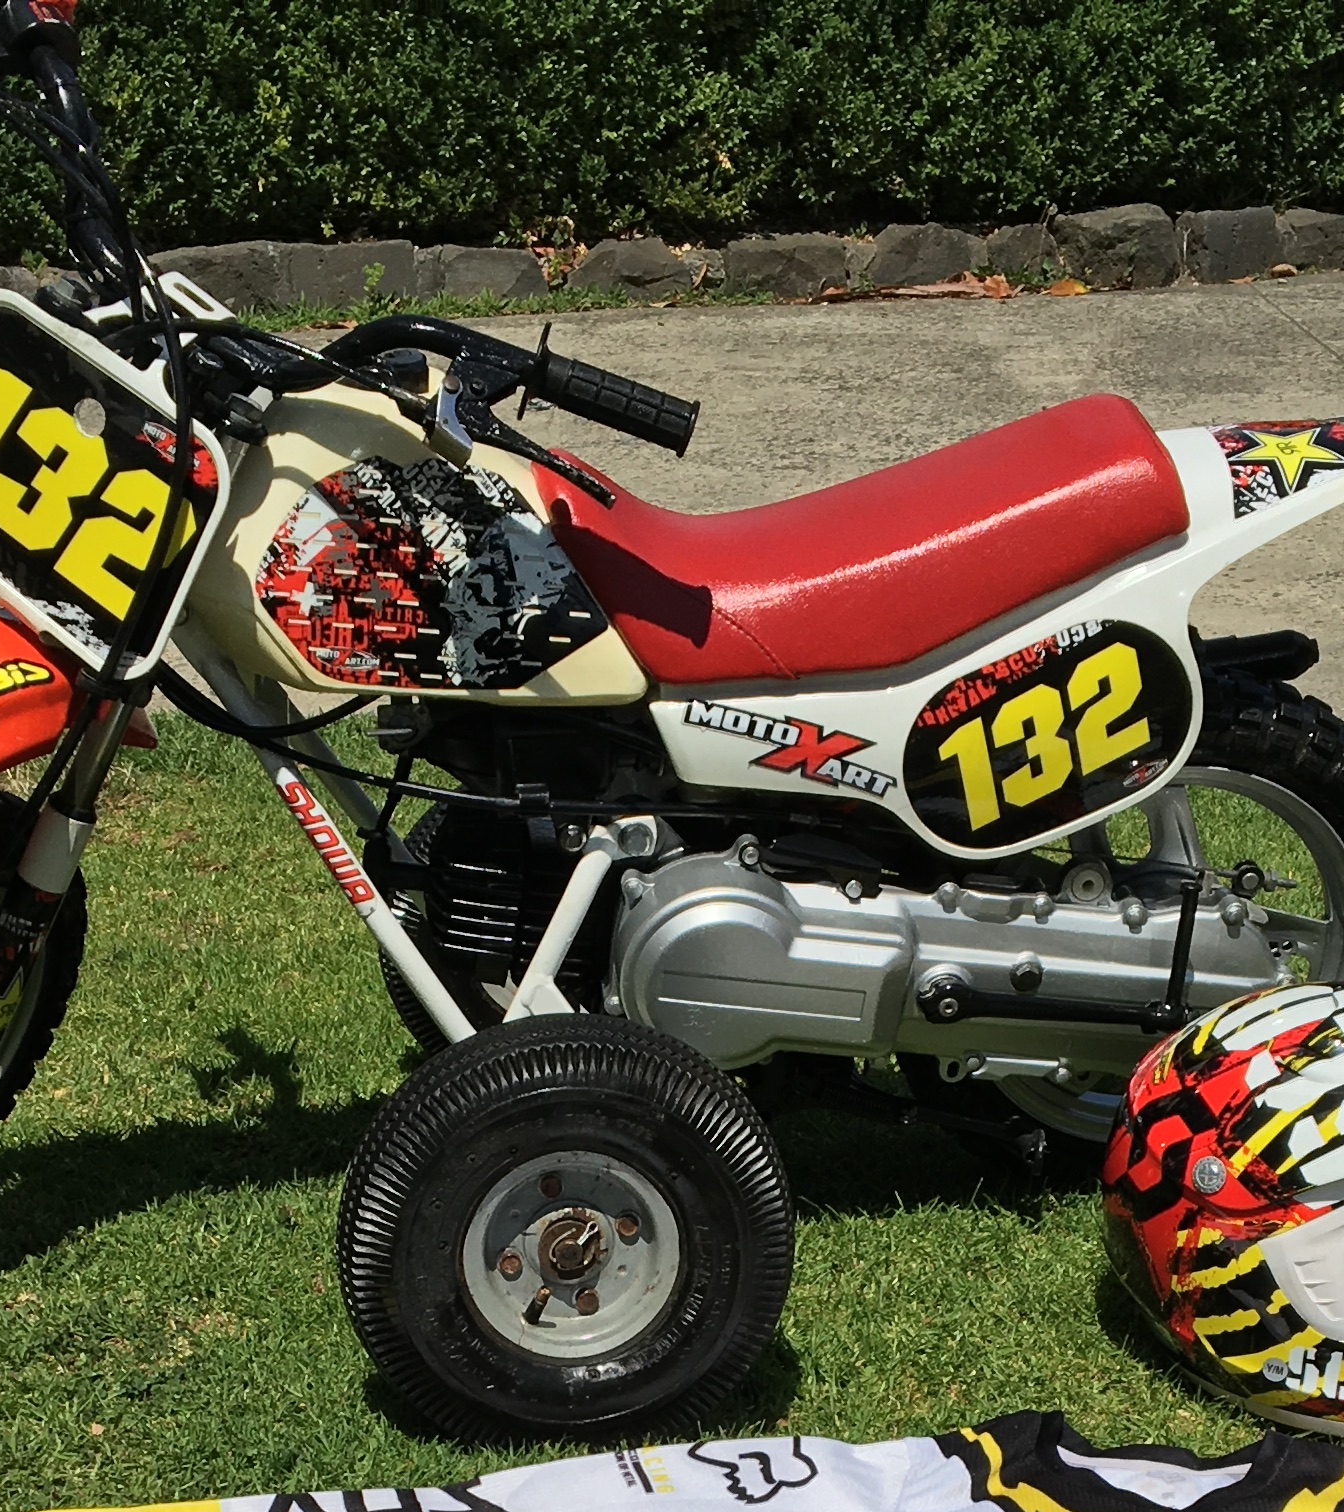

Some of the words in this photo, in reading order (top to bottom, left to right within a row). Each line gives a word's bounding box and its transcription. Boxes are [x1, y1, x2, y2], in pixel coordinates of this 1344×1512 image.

[688, 699, 801, 746] MOTO
[817, 758, 895, 796] ART
[938, 642, 1150, 831] 132
[276, 781, 375, 905] SHOWA
